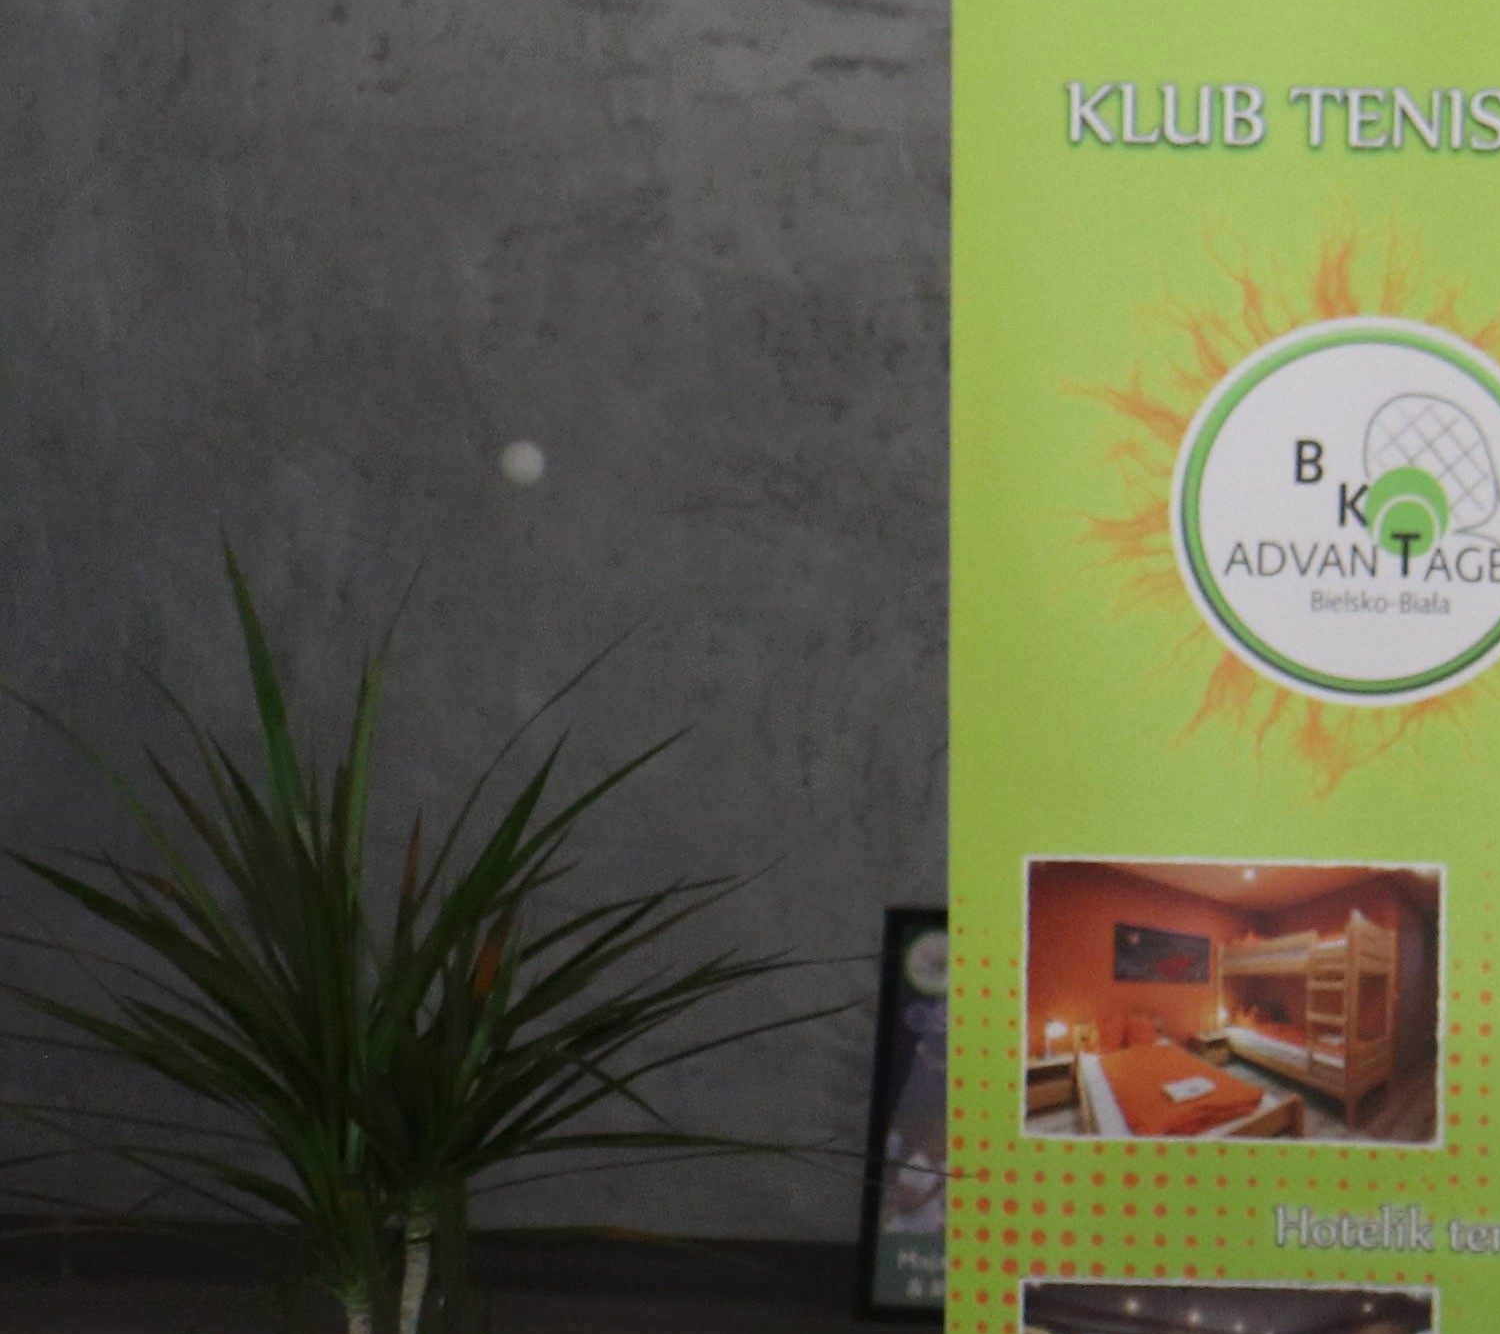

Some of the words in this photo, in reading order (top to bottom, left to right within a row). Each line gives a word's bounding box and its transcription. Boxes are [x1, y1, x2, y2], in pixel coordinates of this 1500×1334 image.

[1066, 81, 1266, 148] KLUB
[1294, 439, 1324, 485] B
[1338, 482, 1370, 528] K
[1310, 589, 1451, 615] Bielsko-Biała
[1274, 1204, 1435, 1252] Hotelik
